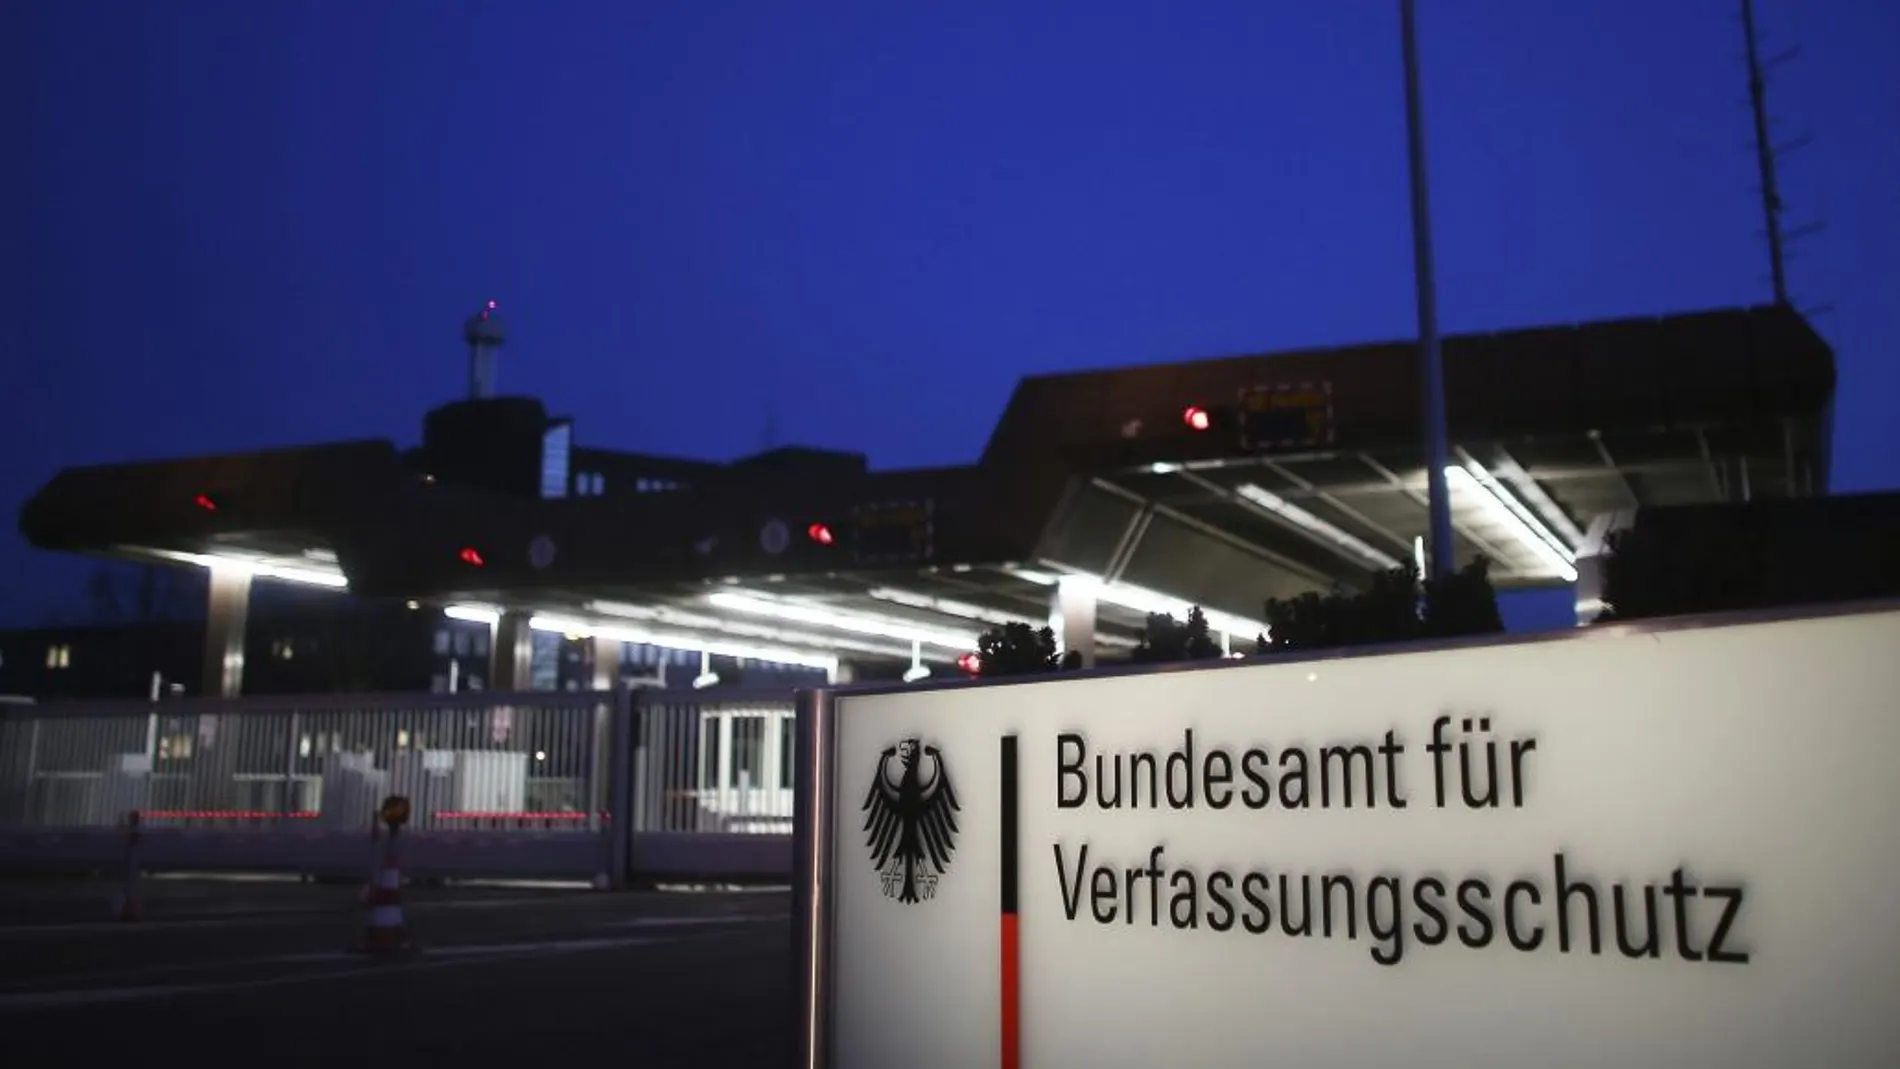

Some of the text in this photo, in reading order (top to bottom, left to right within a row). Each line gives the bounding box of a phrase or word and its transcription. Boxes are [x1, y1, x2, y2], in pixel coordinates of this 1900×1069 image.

[1057, 715, 1537, 809] Bundesamt für
[1053, 843, 1751, 965] Verfassungsschutz
